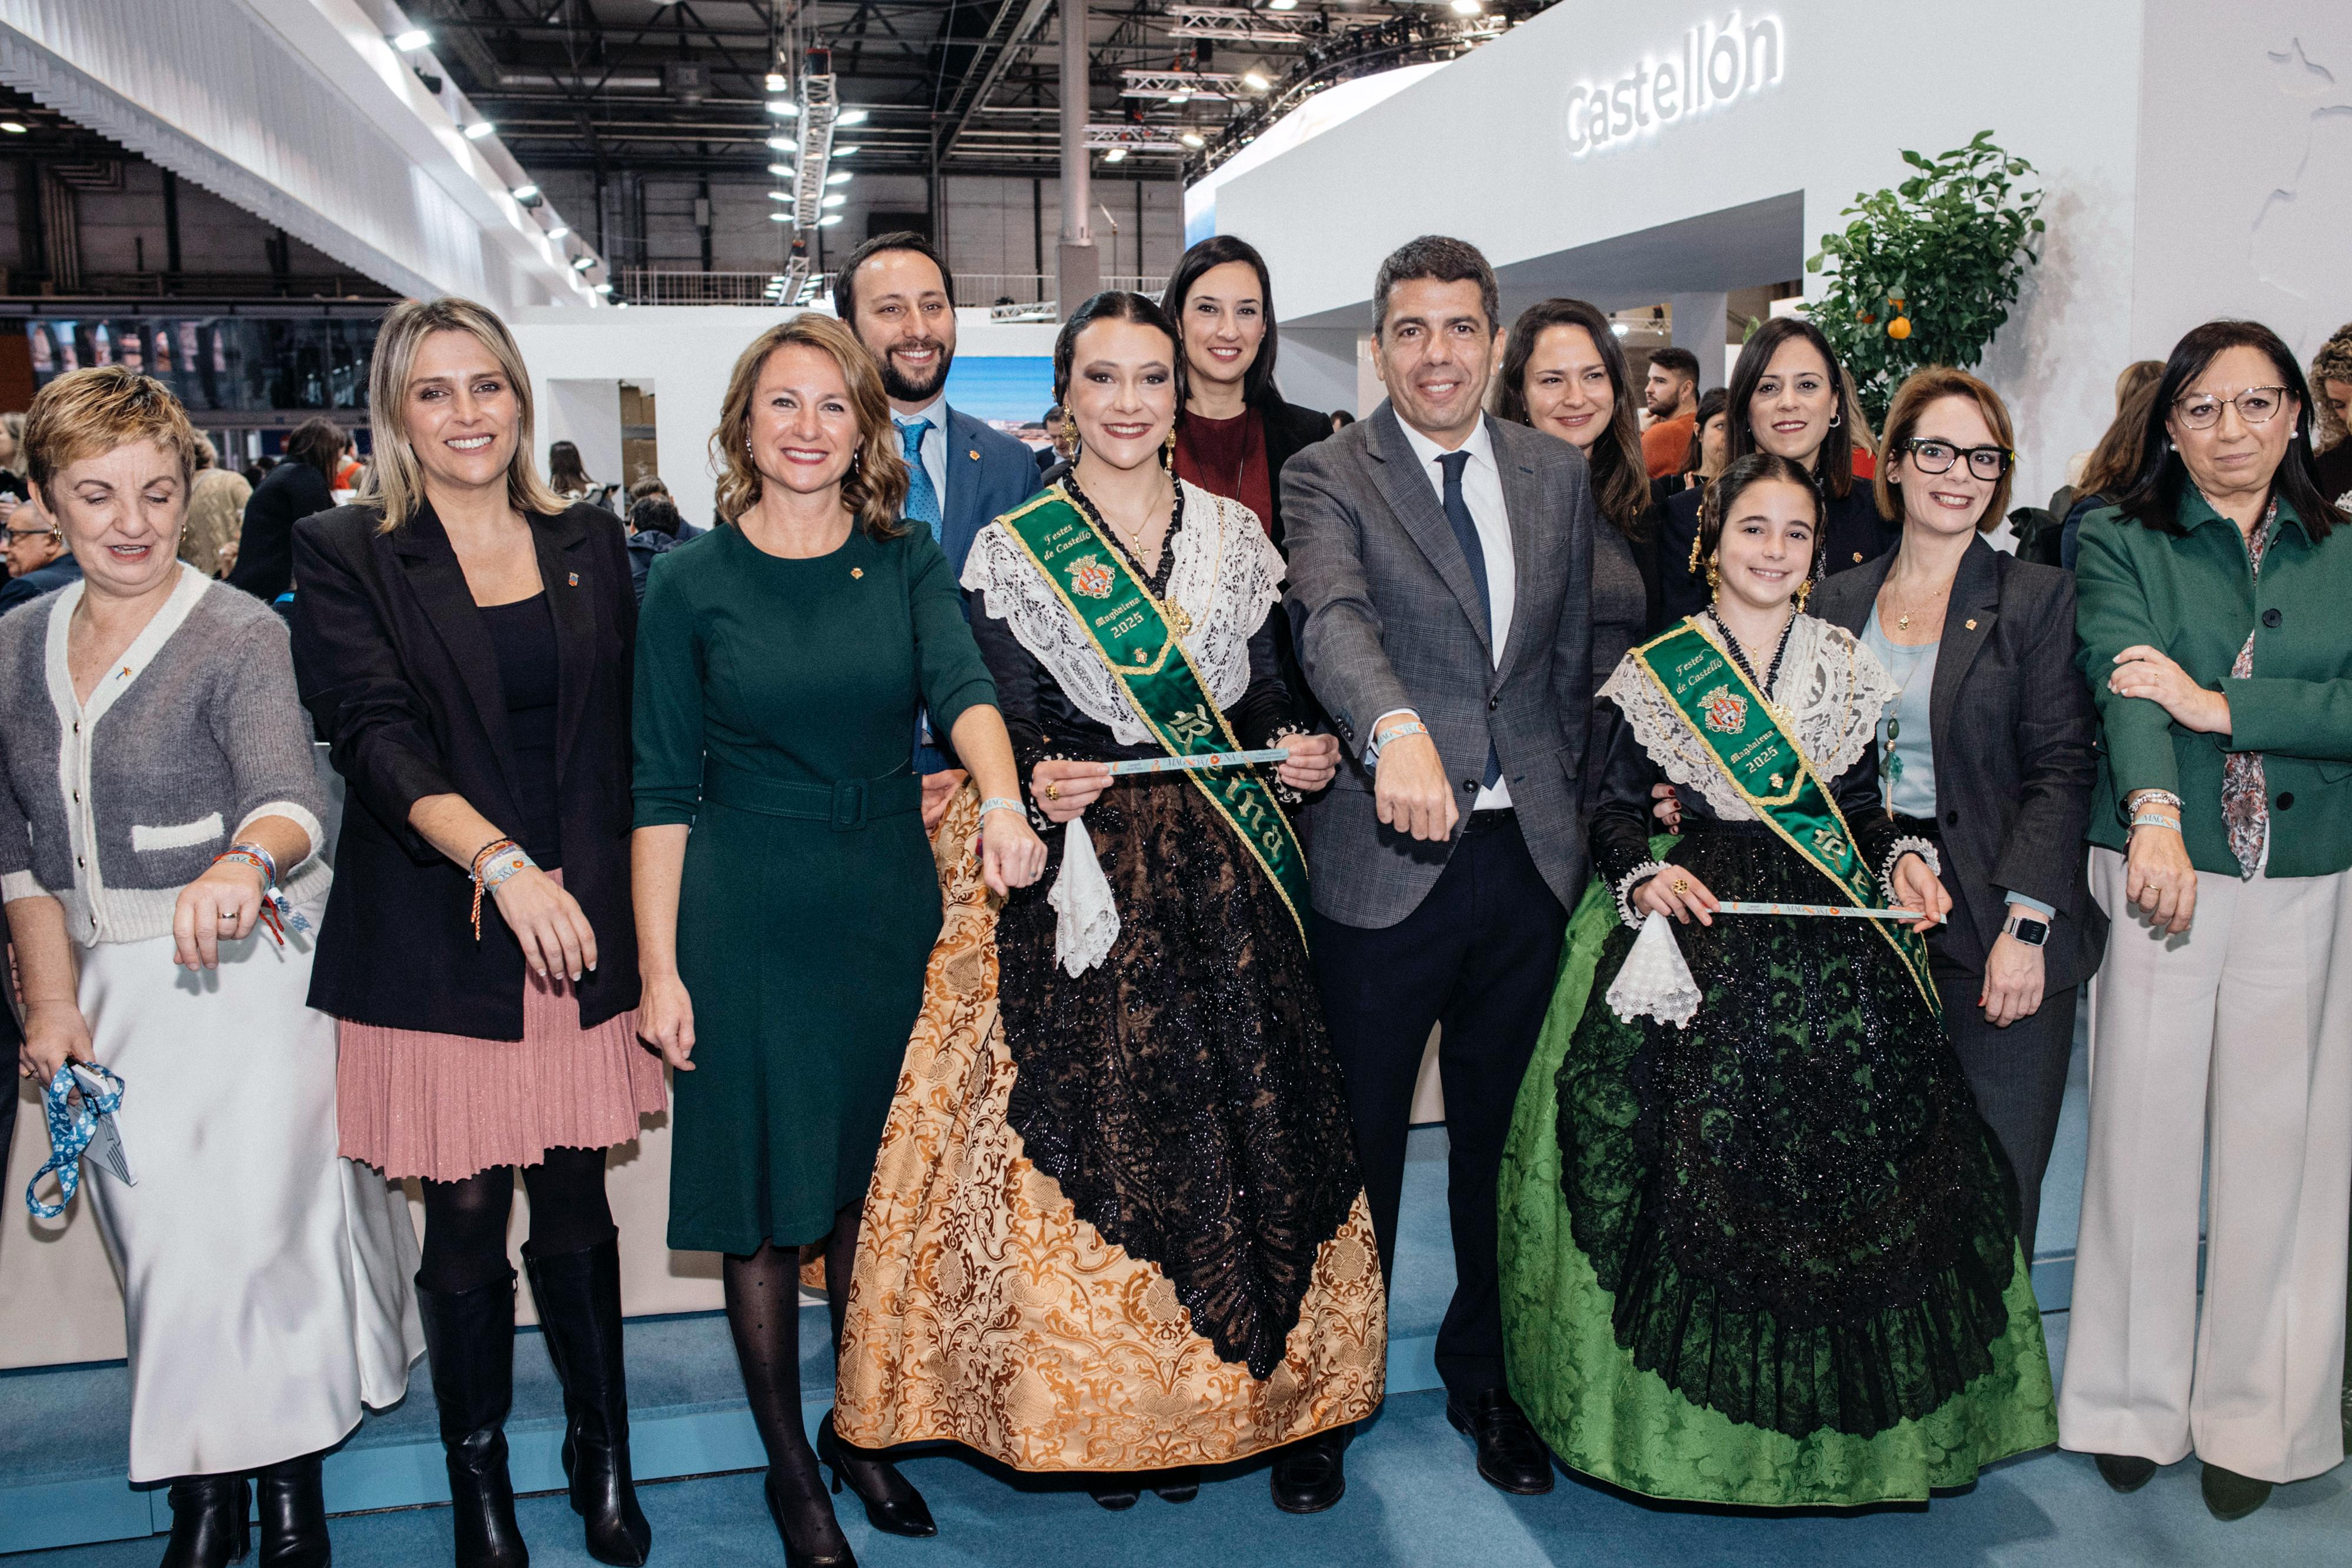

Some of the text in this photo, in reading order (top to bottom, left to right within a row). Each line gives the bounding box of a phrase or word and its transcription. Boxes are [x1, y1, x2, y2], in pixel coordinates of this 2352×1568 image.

[1044, 524, 1073, 546] Festes
[1044, 550, 1054, 561] de
[1095, 597, 1141, 627] Magdalena
[1110, 611, 1144, 638] 2025
[1676, 649, 1713, 677] Festes
[1676, 658, 1722, 694] de Castelló
[1730, 730, 1774, 764] Magdalena
[1745, 745, 1778, 774] 2025
